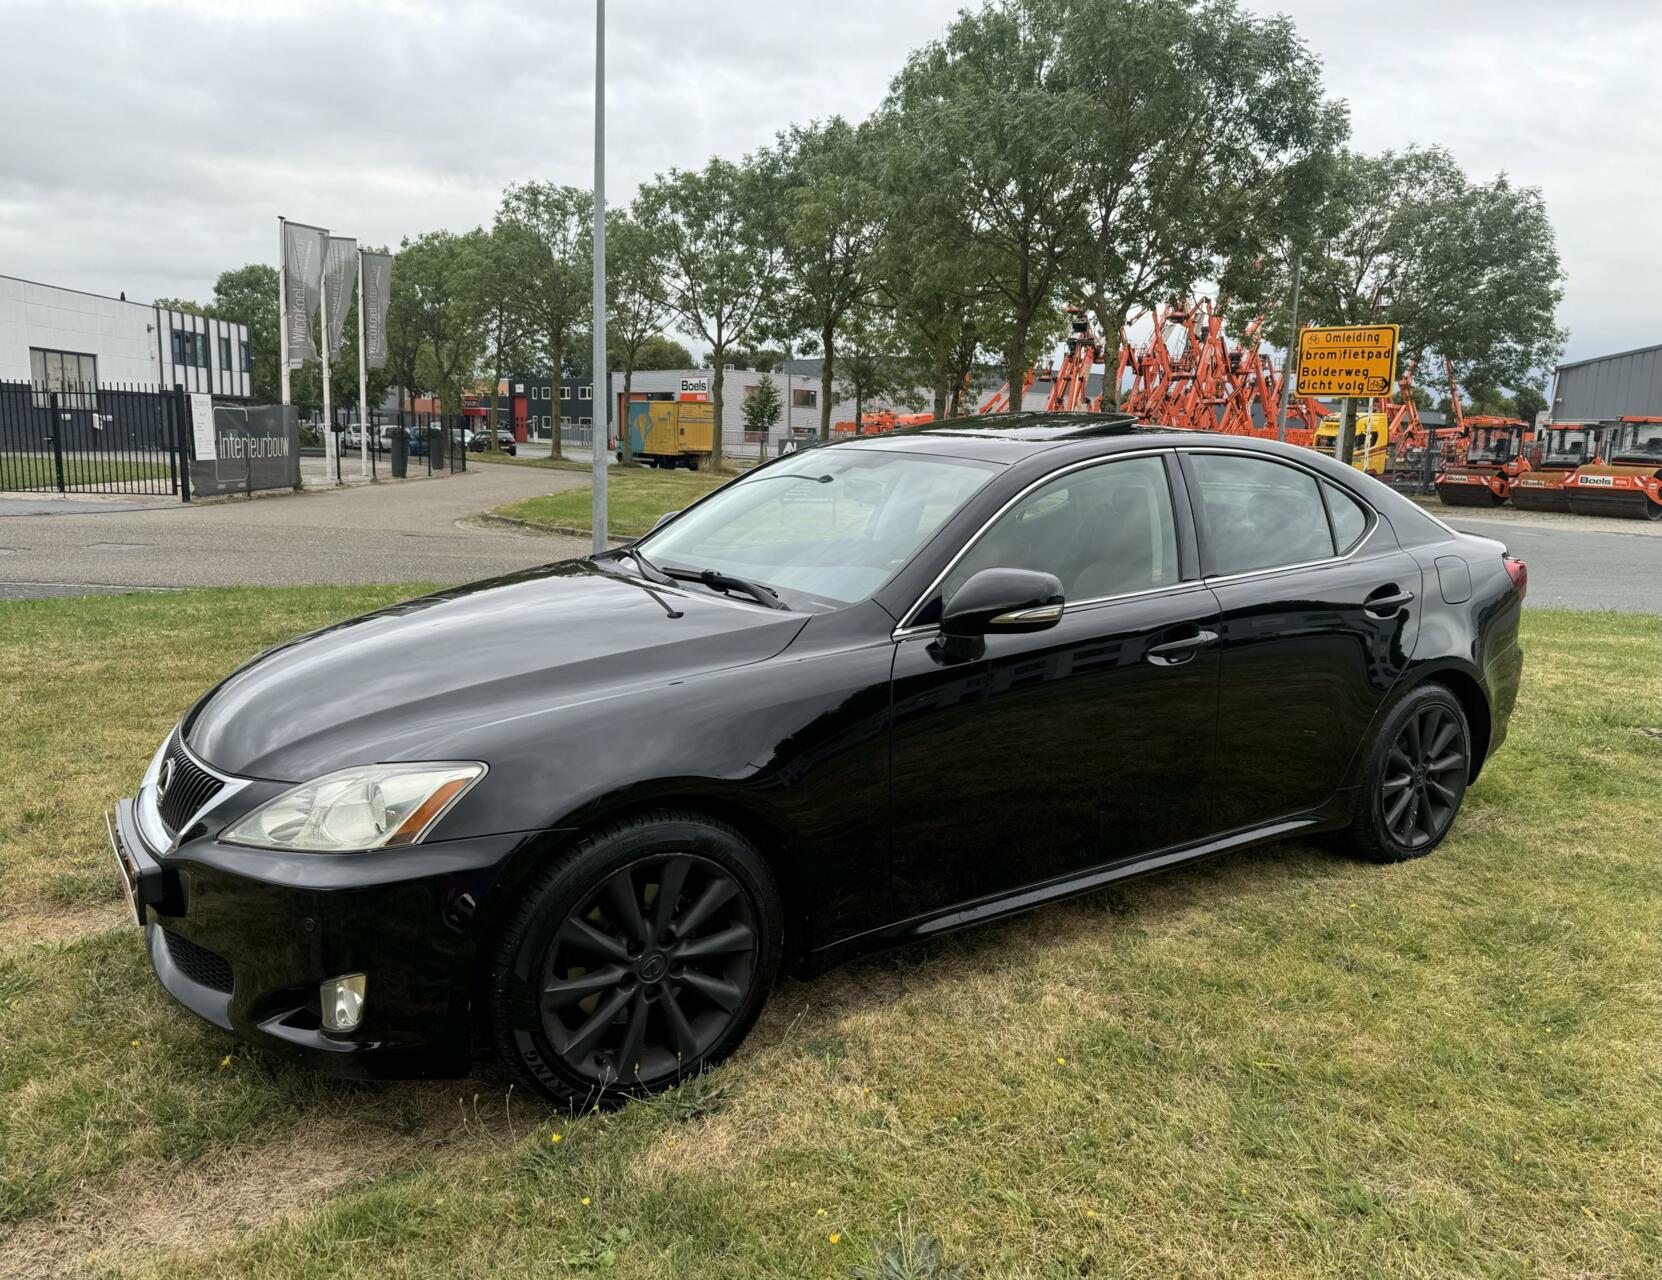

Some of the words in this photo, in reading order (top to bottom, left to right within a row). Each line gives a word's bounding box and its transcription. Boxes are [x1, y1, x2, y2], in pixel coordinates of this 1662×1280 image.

[1325, 332, 1380, 345] Omleiding
[1302, 366, 1369, 379] Bolderweg
[681, 379, 707, 391] Boels
[1299, 380, 1333, 390] dicht
[1338, 380, 1365, 394] volg
[218, 430, 290, 459] Interieurbouw
[1580, 476, 1611, 485] Boels
